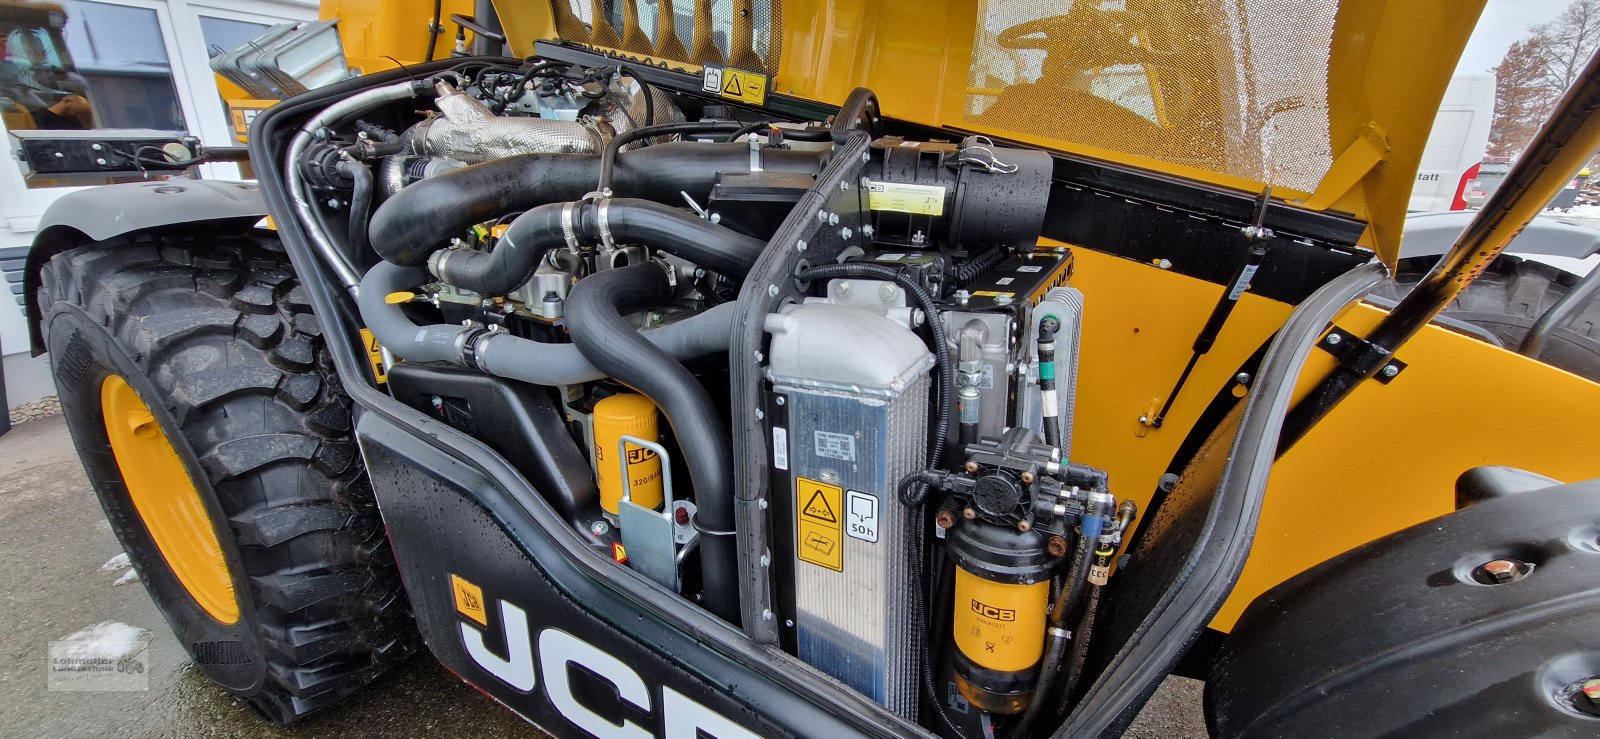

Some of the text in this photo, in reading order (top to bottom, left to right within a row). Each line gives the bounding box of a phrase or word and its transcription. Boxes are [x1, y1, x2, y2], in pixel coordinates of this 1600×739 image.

[1417, 173, 1440, 181] tatt
[869, 184, 884, 192] CB
[628, 447, 660, 465] JC
[972, 599, 1016, 622] JCB
